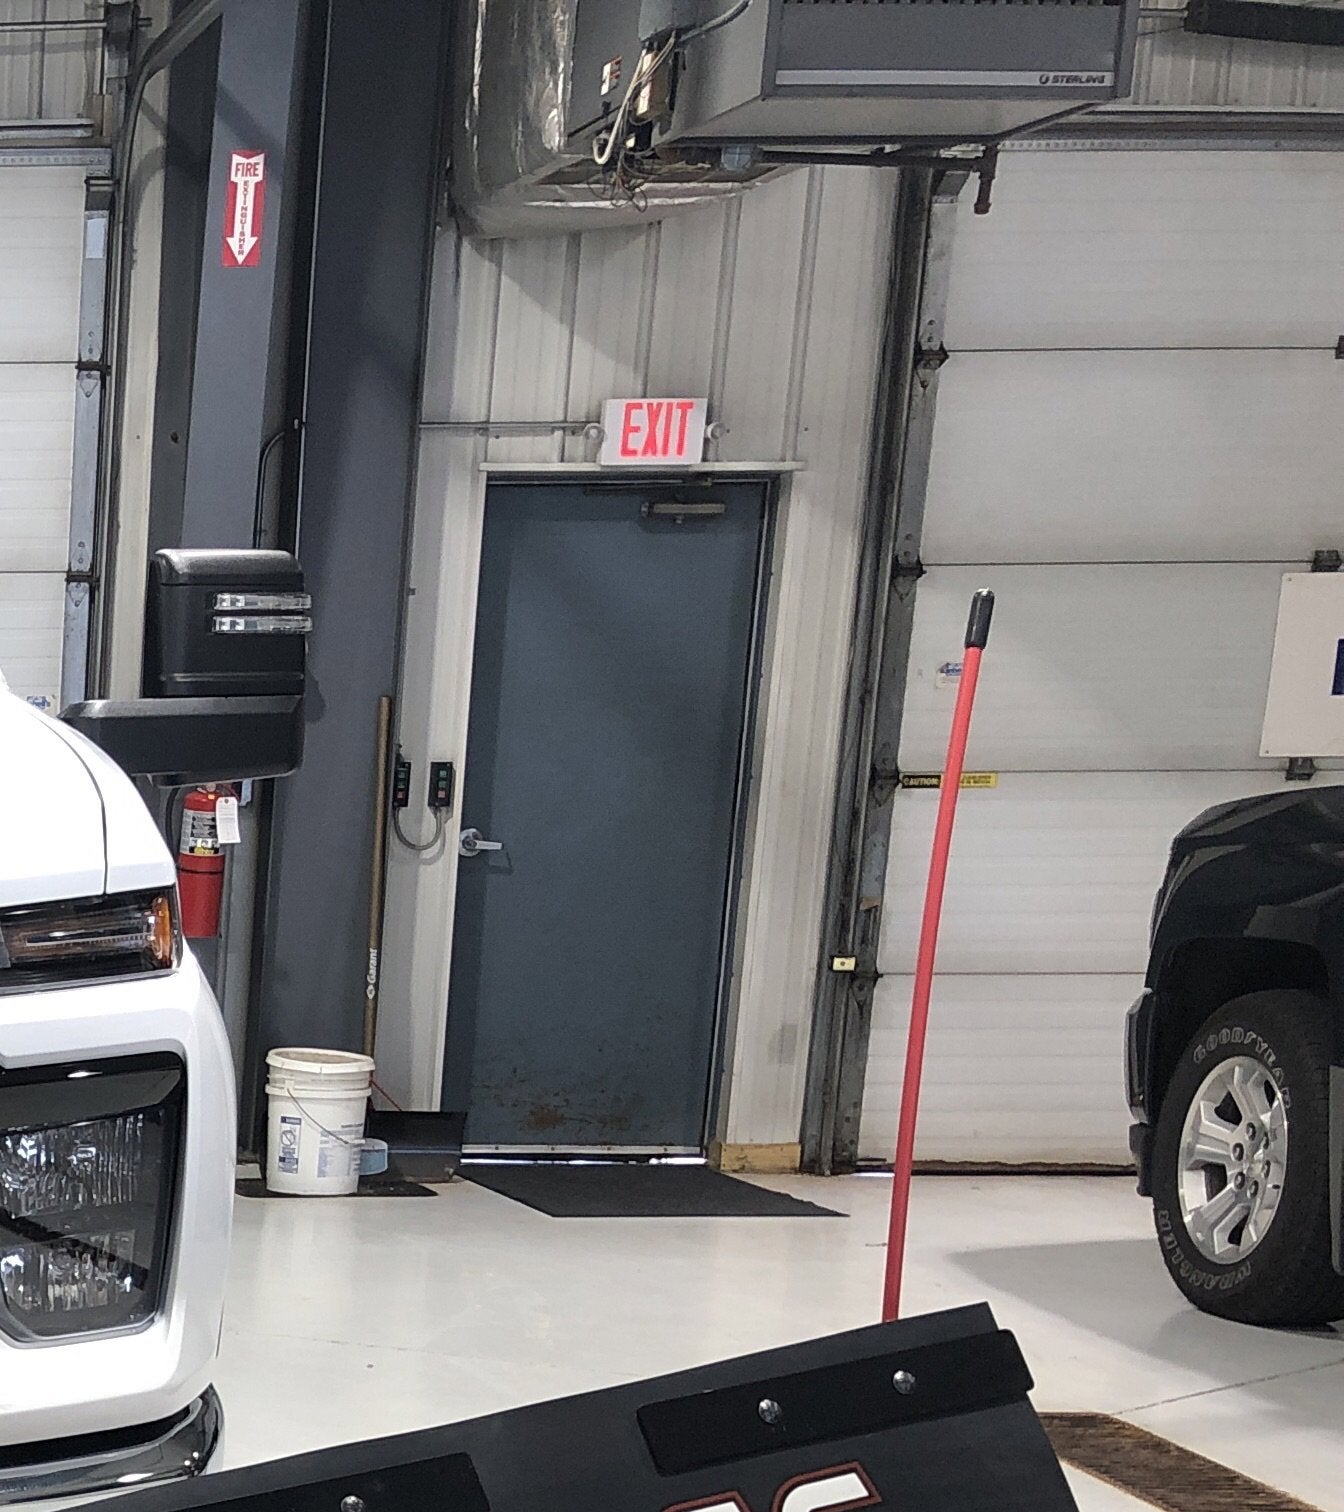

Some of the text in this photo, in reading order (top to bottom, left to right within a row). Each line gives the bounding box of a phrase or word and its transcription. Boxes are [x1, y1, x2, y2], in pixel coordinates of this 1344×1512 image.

[234, 161, 261, 178] FIRE
[237, 180, 250, 256] EXTINGUISHER
[620, 402, 694, 457] EXIT
[1192, 1026, 1292, 1109] GOODYEAR
[1158, 1209, 1254, 1292] WRANGLER
